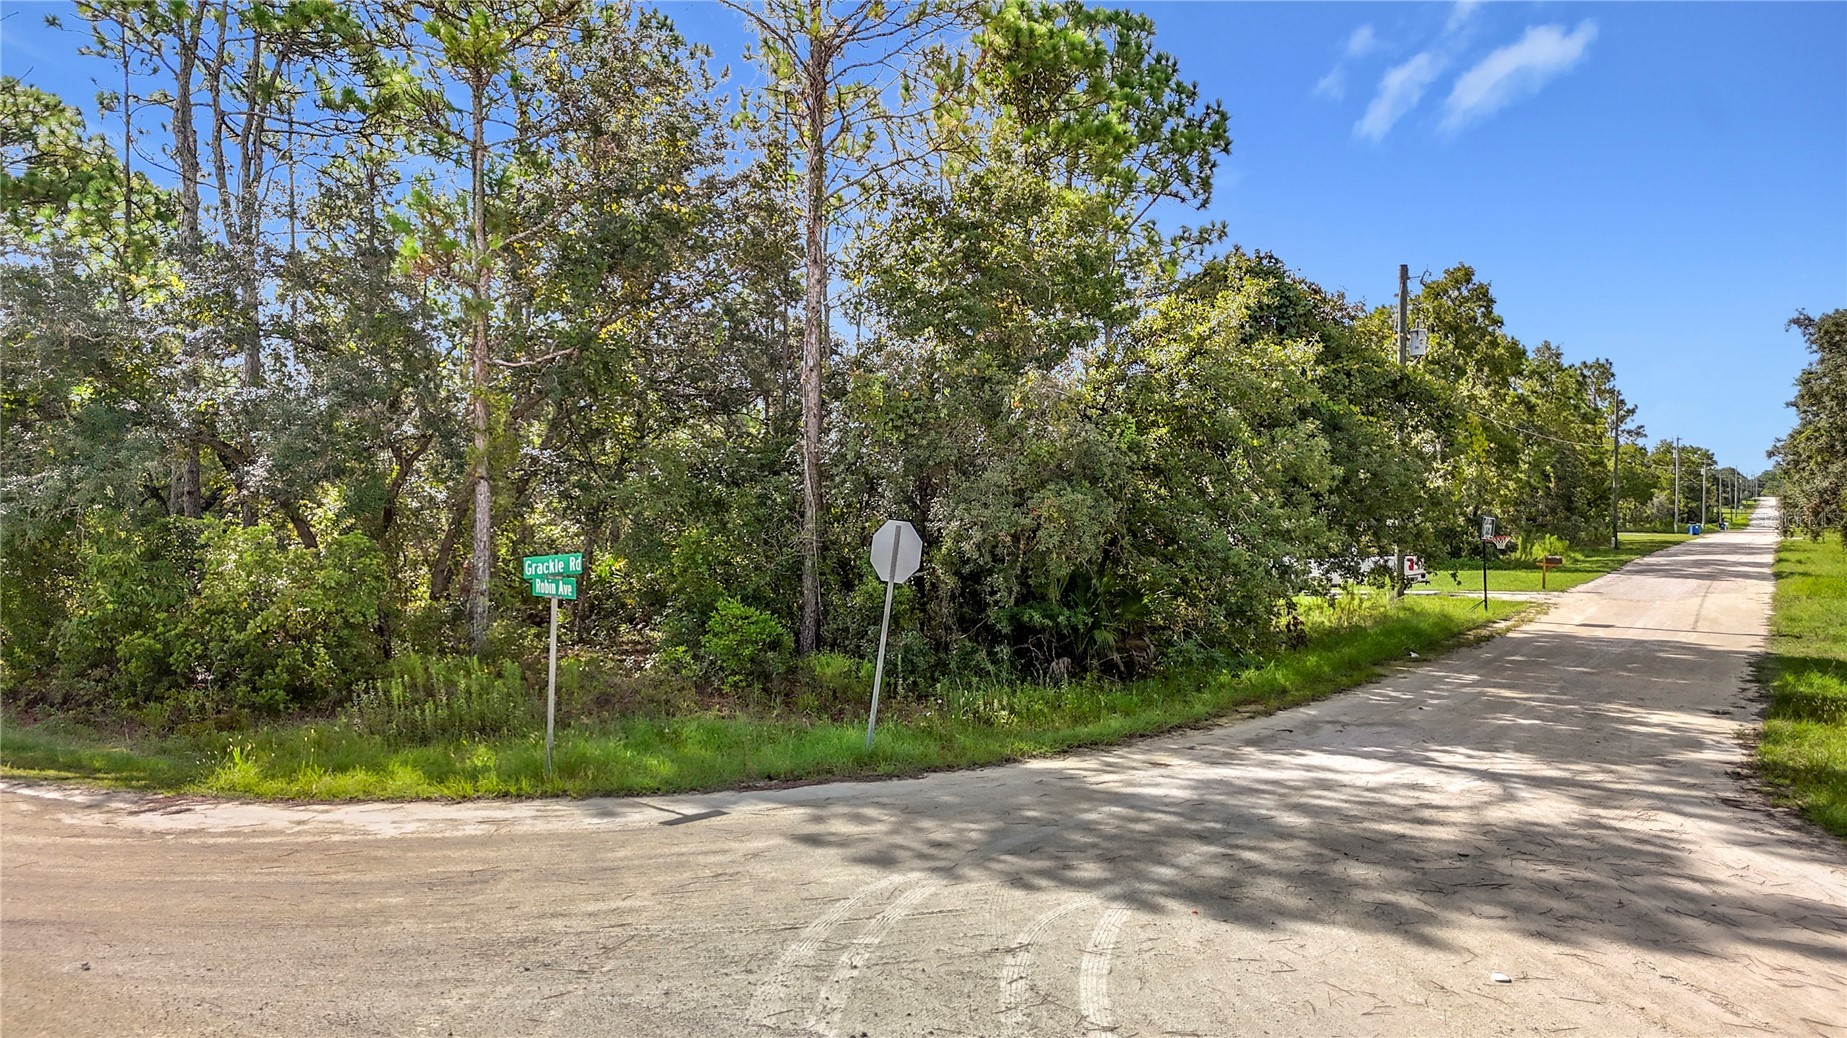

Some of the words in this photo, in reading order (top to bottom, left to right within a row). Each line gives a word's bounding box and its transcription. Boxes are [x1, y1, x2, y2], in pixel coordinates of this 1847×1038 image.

[525, 559, 564, 575] Grackle
[569, 556, 582, 572] Rd
[535, 578, 556, 595] Robin
[558, 580, 572, 596] Ave
